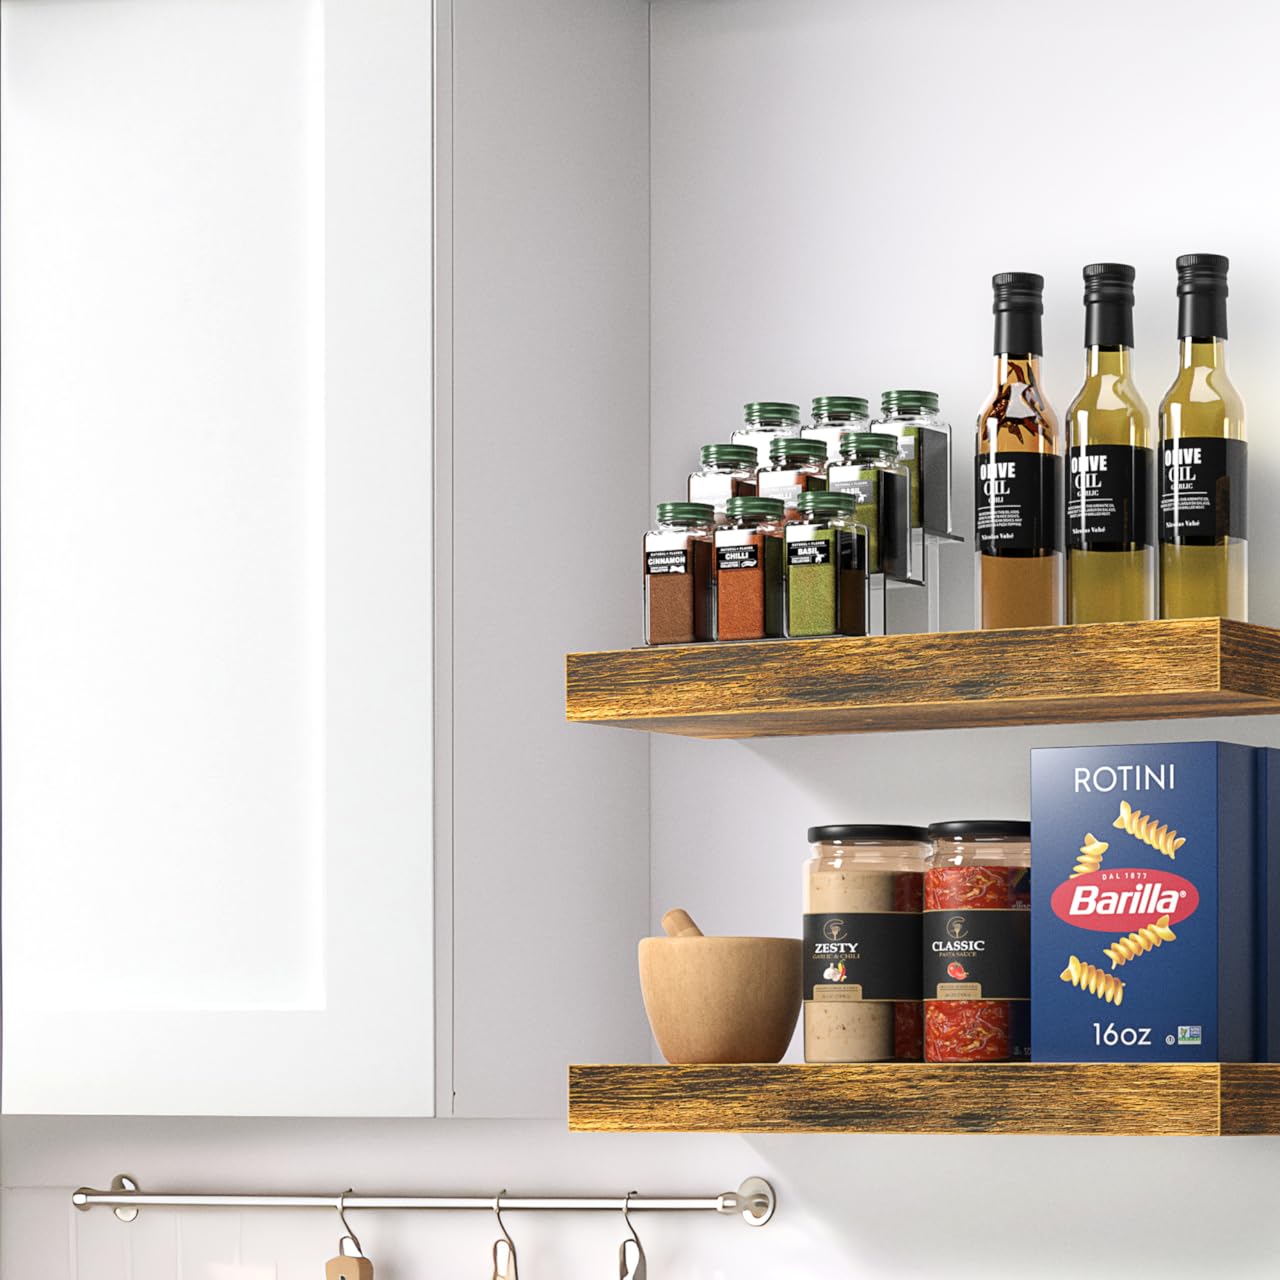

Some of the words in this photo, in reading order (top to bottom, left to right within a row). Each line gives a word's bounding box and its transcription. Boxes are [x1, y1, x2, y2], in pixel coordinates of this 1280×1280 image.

[1165, 448, 1202, 466] OIVE
[1071, 455, 1107, 473] OIVE
[980, 462, 1016, 480] OIVE
[724, 552, 749, 560] CHILLI
[797, 548, 819, 556] BASIL
[648, 556, 686, 566] CINNAMON
[1074, 763, 1176, 793] ROTINI
[1102, 873, 1120, 881] DAL
[1124, 872, 1148, 880] 1877
[815, 943, 859, 954] ZESTY
[932, 941, 985, 952] CLASSIC
[1093, 1022, 1152, 1046] 16oz
